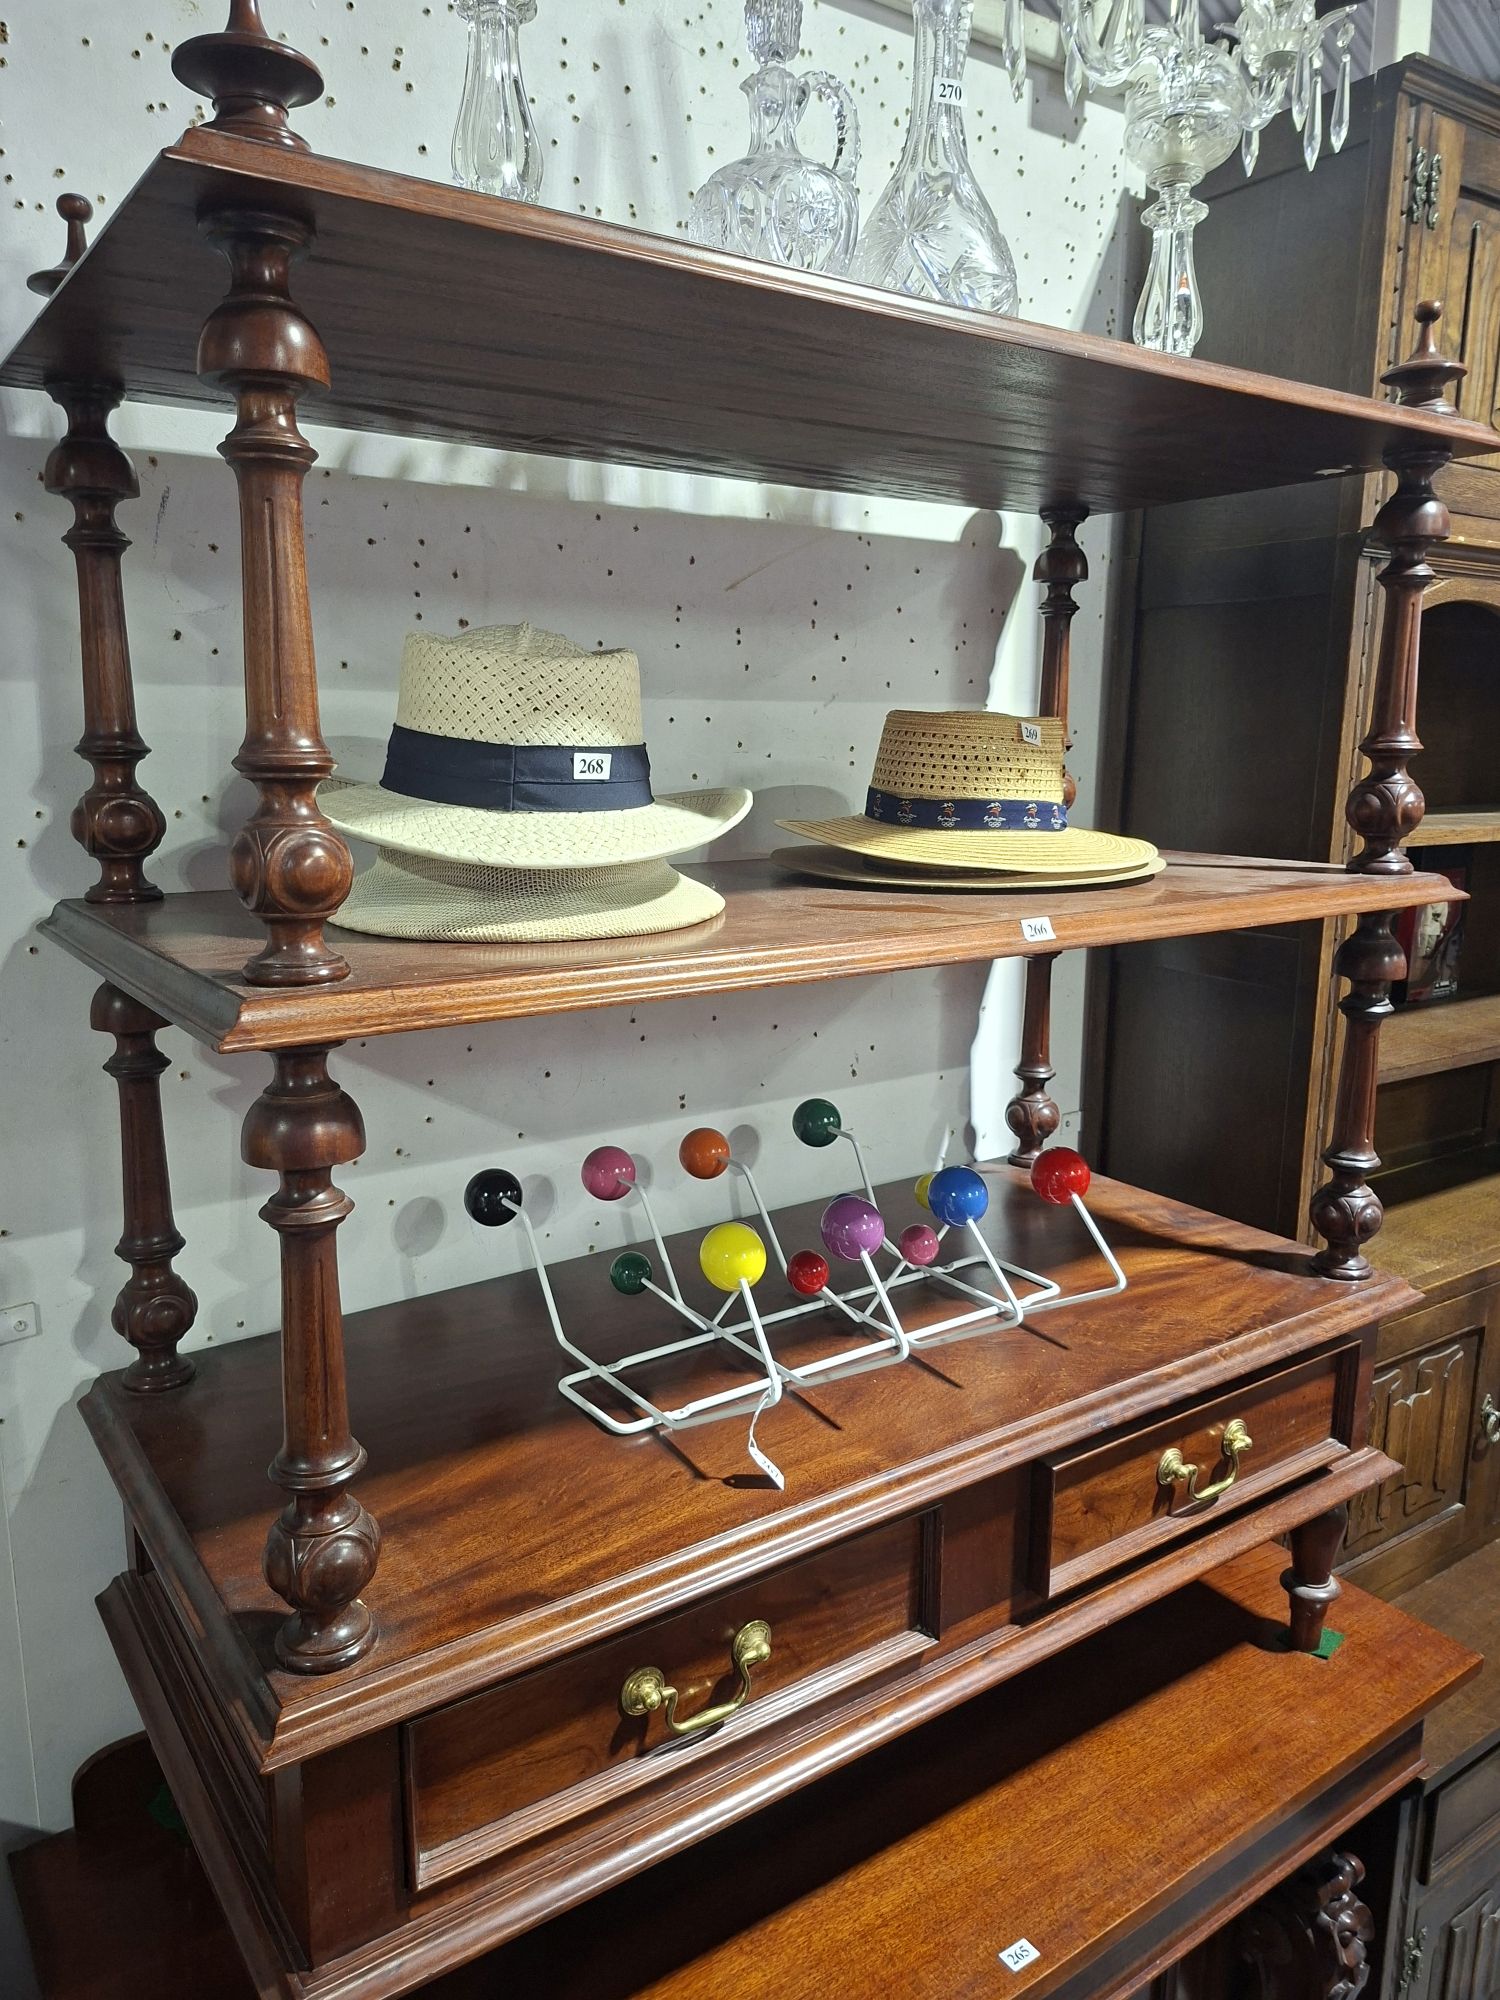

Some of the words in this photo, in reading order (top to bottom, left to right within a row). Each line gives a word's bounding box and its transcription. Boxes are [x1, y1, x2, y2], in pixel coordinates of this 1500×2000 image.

[939, 83, 962, 101] 270
[1025, 726, 1038, 740] 269
[579, 759, 604, 774] 268
[1027, 924, 1047, 937] 266
[1007, 1945, 1030, 1965] 265
